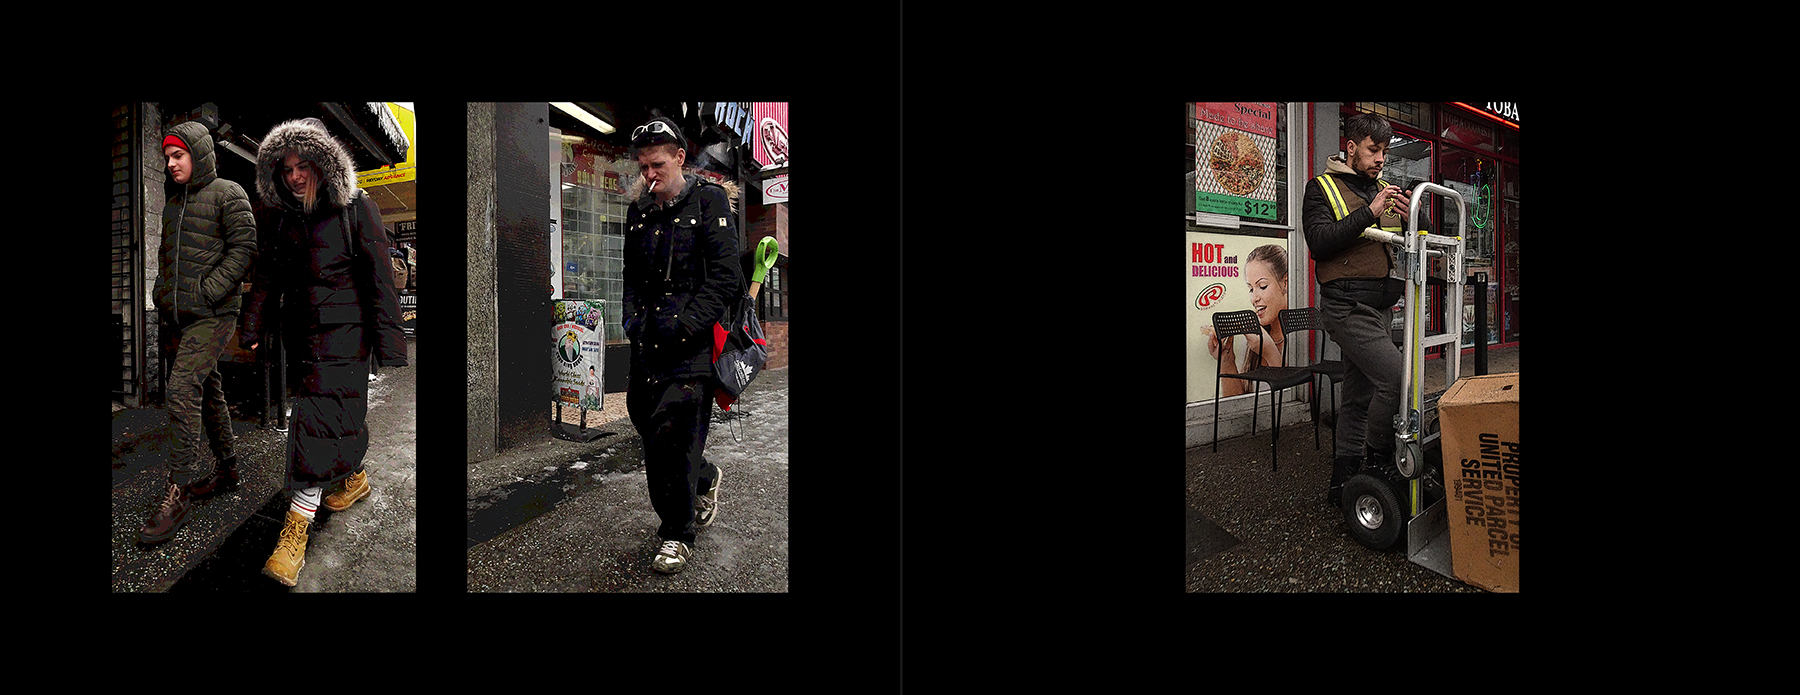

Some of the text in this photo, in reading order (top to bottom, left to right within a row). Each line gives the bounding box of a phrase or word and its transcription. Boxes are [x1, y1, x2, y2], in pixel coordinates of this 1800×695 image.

[1200, 107, 1225, 123] Made
[1227, 115, 1237, 126] to
[1238, 117, 1249, 129] be
[1234, 102, 1271, 120] Special
[1191, 242, 1238, 264] HOT and
[1191, 265, 1239, 278] DELICIOUS
[1460, 458, 1487, 528] SERVICE
[1478, 432, 1510, 558] UNITED PARCEL
